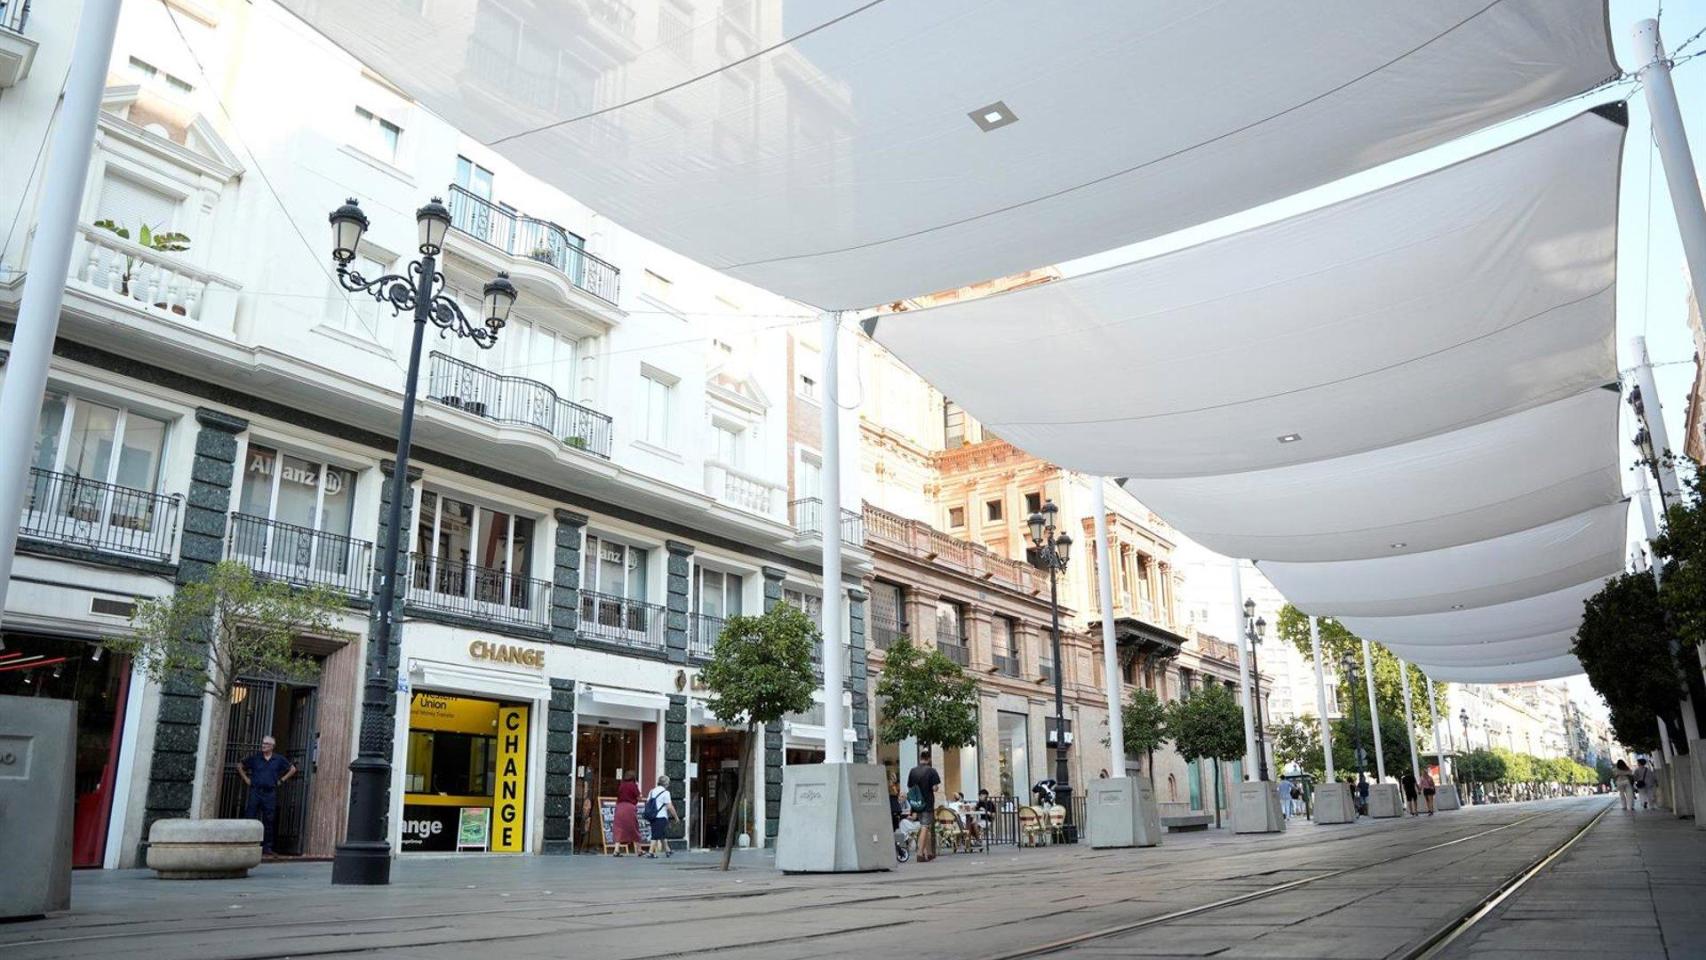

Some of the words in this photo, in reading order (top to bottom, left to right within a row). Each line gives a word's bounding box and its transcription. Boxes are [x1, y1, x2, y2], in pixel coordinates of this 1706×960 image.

[250, 455, 315, 485] Allanz
[469, 640, 545, 667] CHANGE
[420, 698, 447, 709] Union
[501, 712, 520, 847] CHANGE
